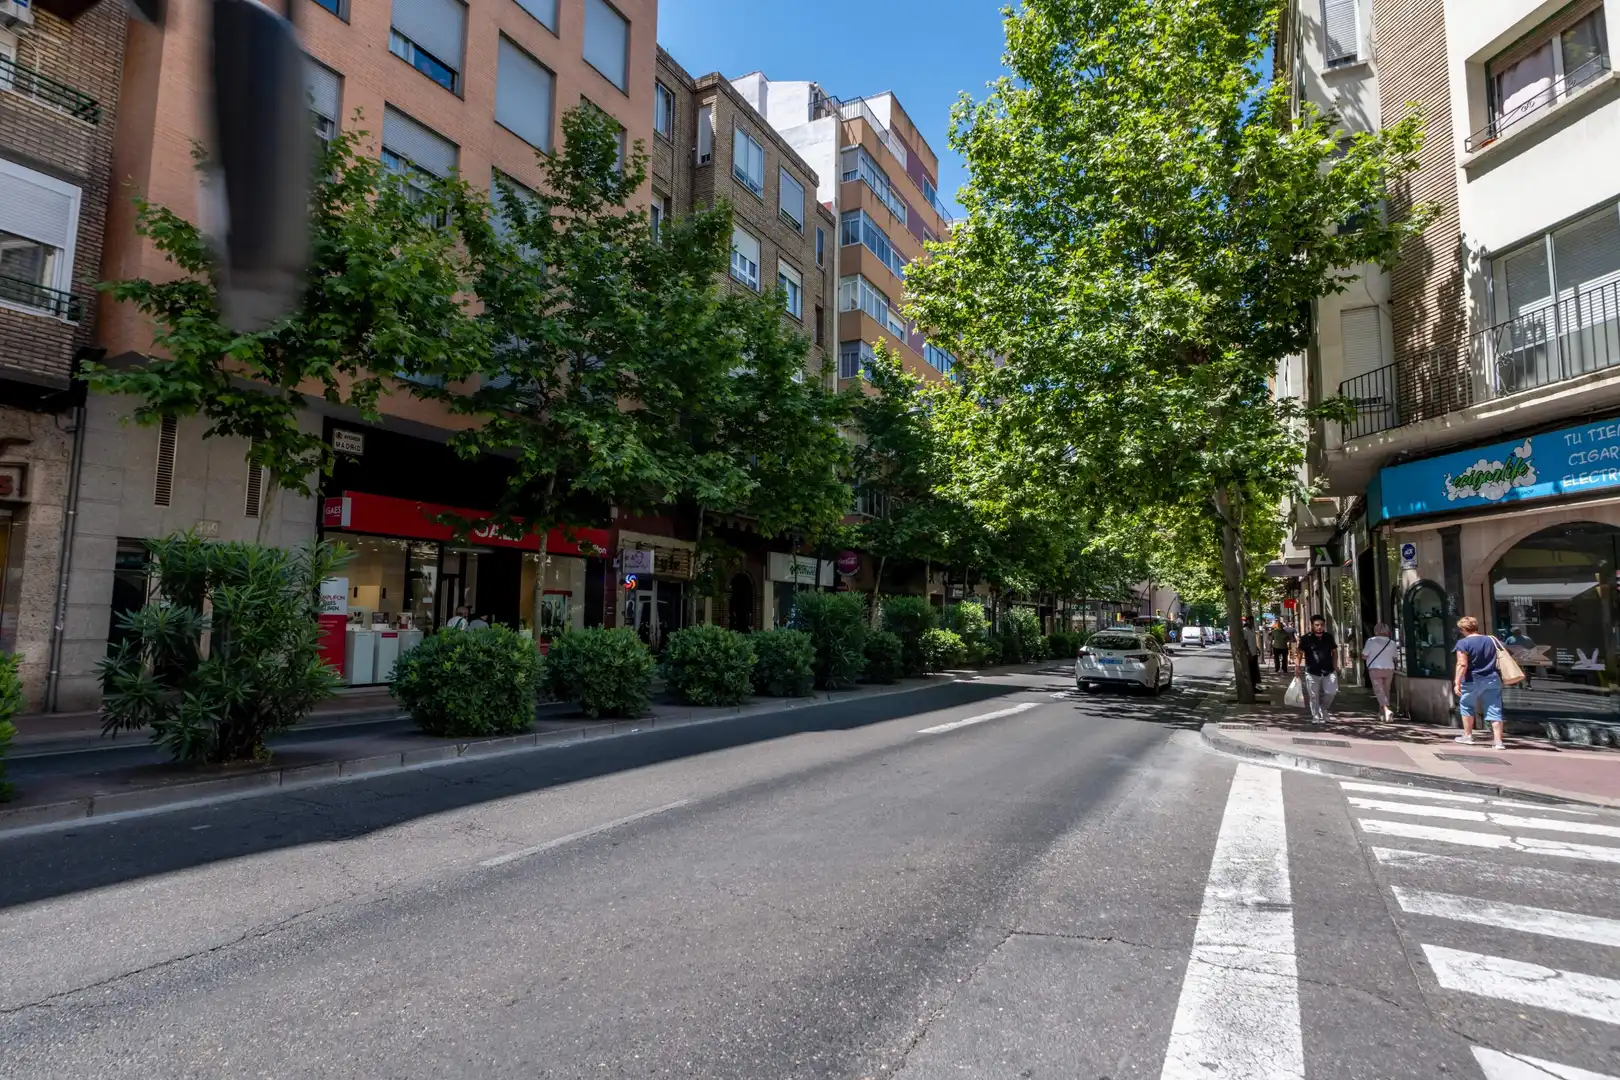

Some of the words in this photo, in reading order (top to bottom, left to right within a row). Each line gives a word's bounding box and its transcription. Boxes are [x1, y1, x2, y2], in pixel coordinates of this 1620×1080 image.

[1563, 433, 1582, 446] TU
[335, 441, 361, 452] MADRID
[1568, 445, 1620, 466] CIGAR
[1562, 467, 1620, 488] ELECTR
[325, 505, 341, 515] GAES
